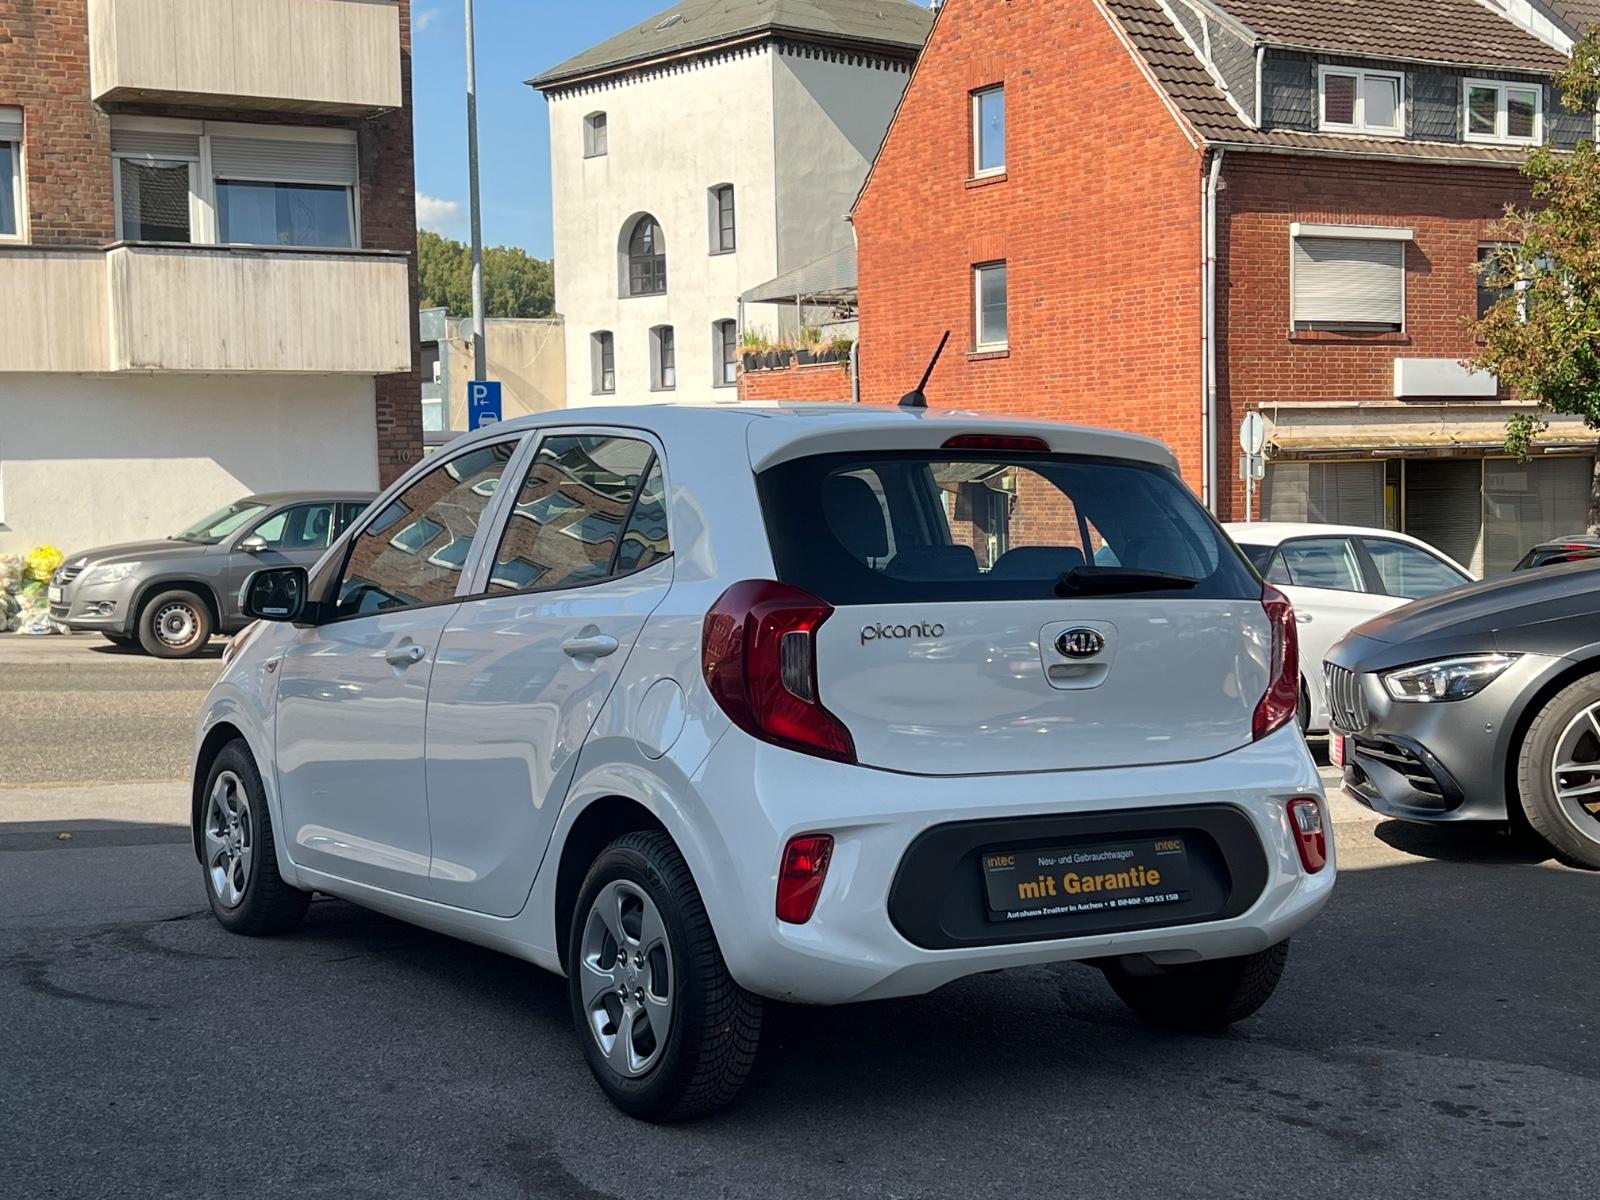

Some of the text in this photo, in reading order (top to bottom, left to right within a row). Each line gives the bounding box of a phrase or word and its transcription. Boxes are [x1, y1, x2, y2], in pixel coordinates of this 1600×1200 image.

[473, 384, 488, 406] P
[397, 450, 410, 462] 10
[861, 620, 945, 646] picanto
[1065, 634, 1101, 653] KIA
[1154, 840, 1181, 851] intec
[987, 855, 1015, 867] intec
[1038, 849, 1135, 867] Neu- und Gebrauchtwagen
[1017, 865, 1161, 900] mit Garantie
[1006, 910, 1043, 920] Autohaus
[1077, 901, 1104, 911] Aachen
